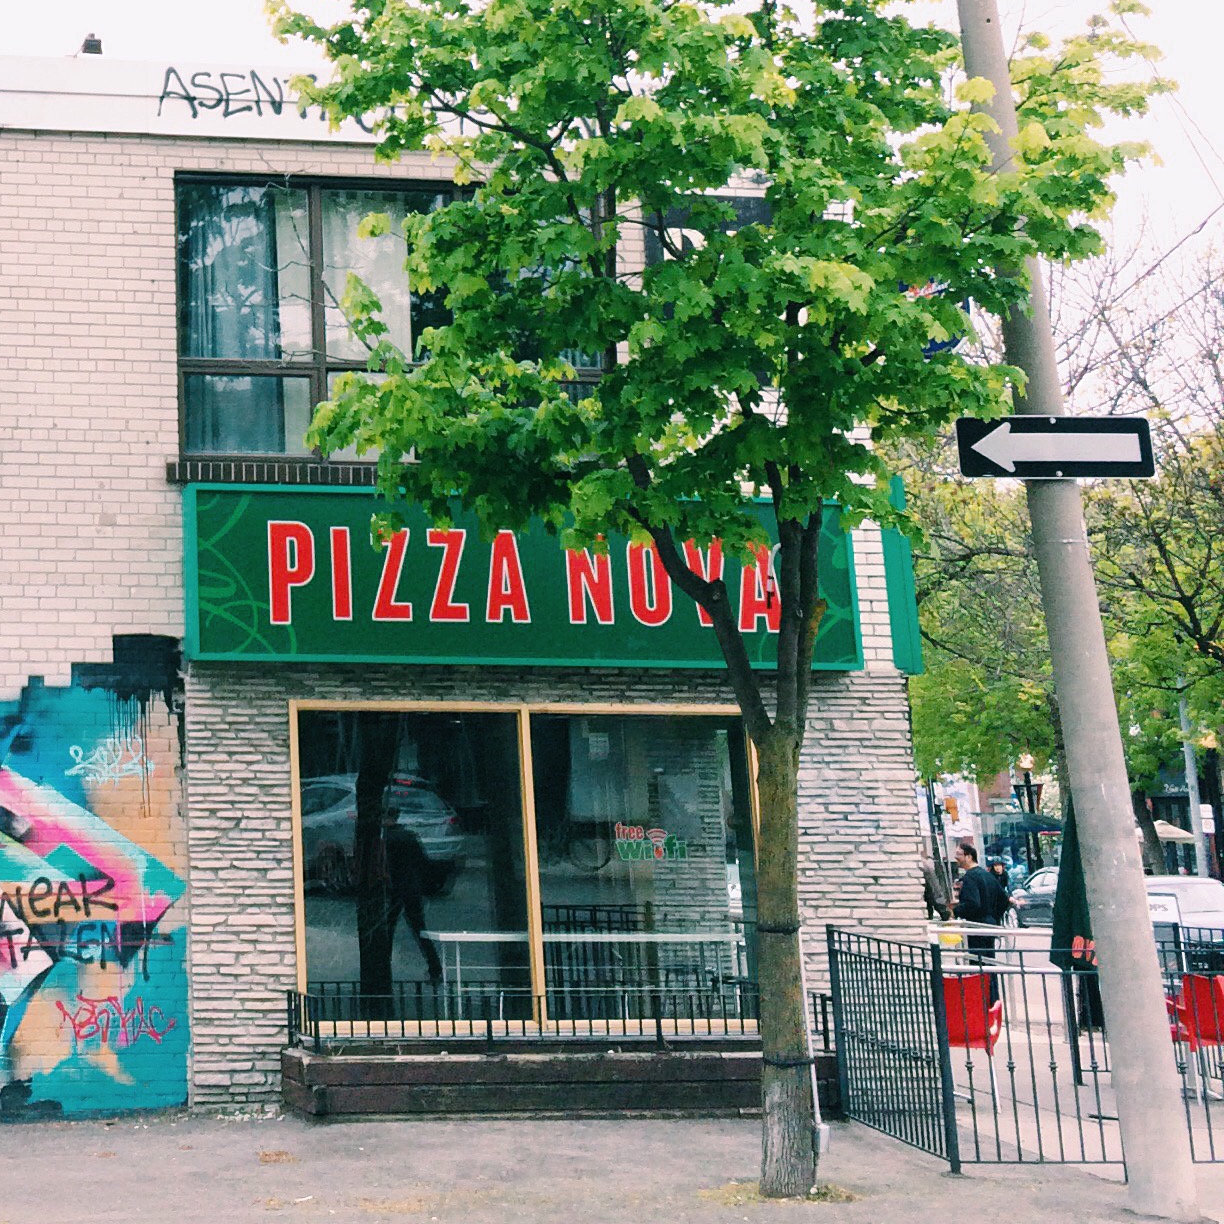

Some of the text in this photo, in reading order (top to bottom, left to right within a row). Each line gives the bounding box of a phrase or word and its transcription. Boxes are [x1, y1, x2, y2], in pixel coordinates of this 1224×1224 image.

[267, 520, 782, 634] PIZZA NOVA
[615, 822, 644, 841] free
